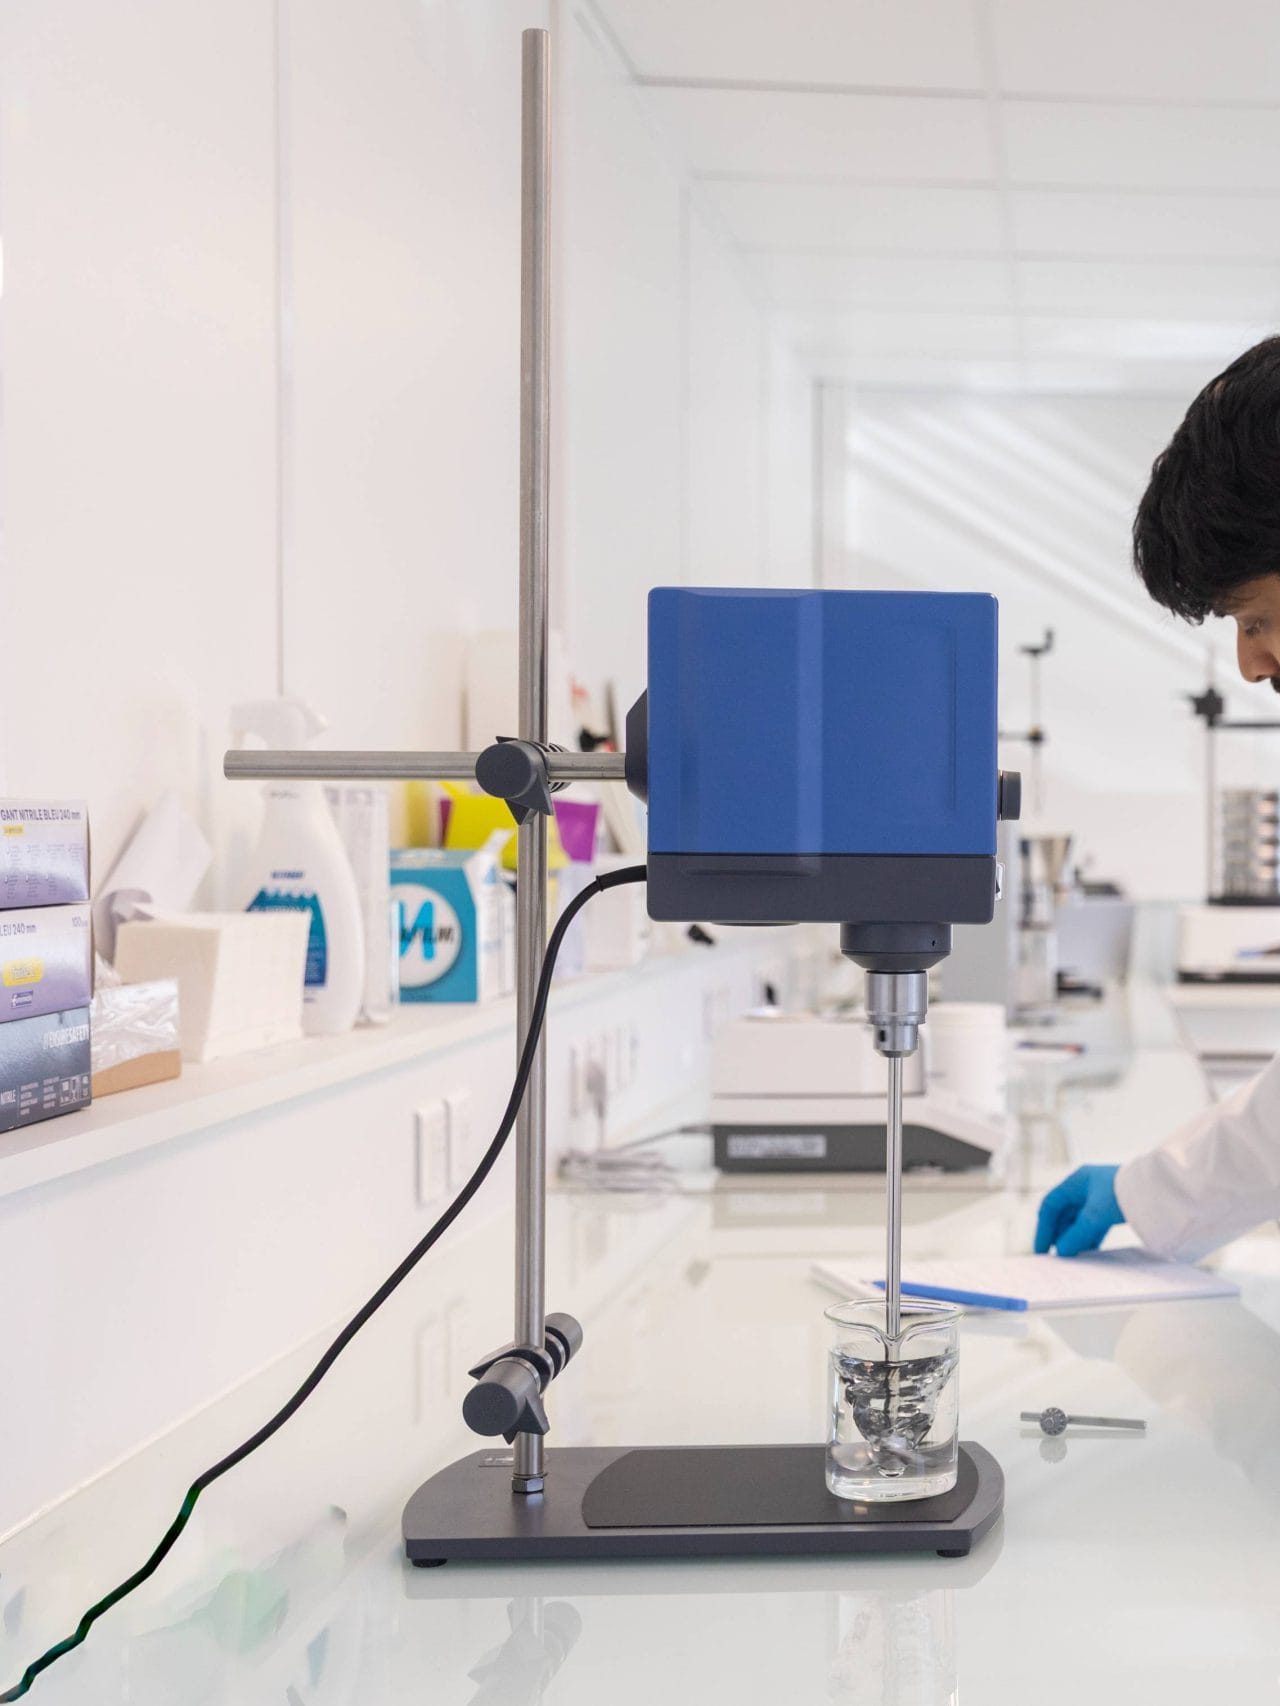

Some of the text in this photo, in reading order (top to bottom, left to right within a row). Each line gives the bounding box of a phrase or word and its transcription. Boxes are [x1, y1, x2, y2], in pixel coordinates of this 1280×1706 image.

[19, 808, 43, 821] NITRILE
[43, 808, 59, 820] BLEU
[60, 808, 71, 820] 240
[13, 922, 25, 935] 240
